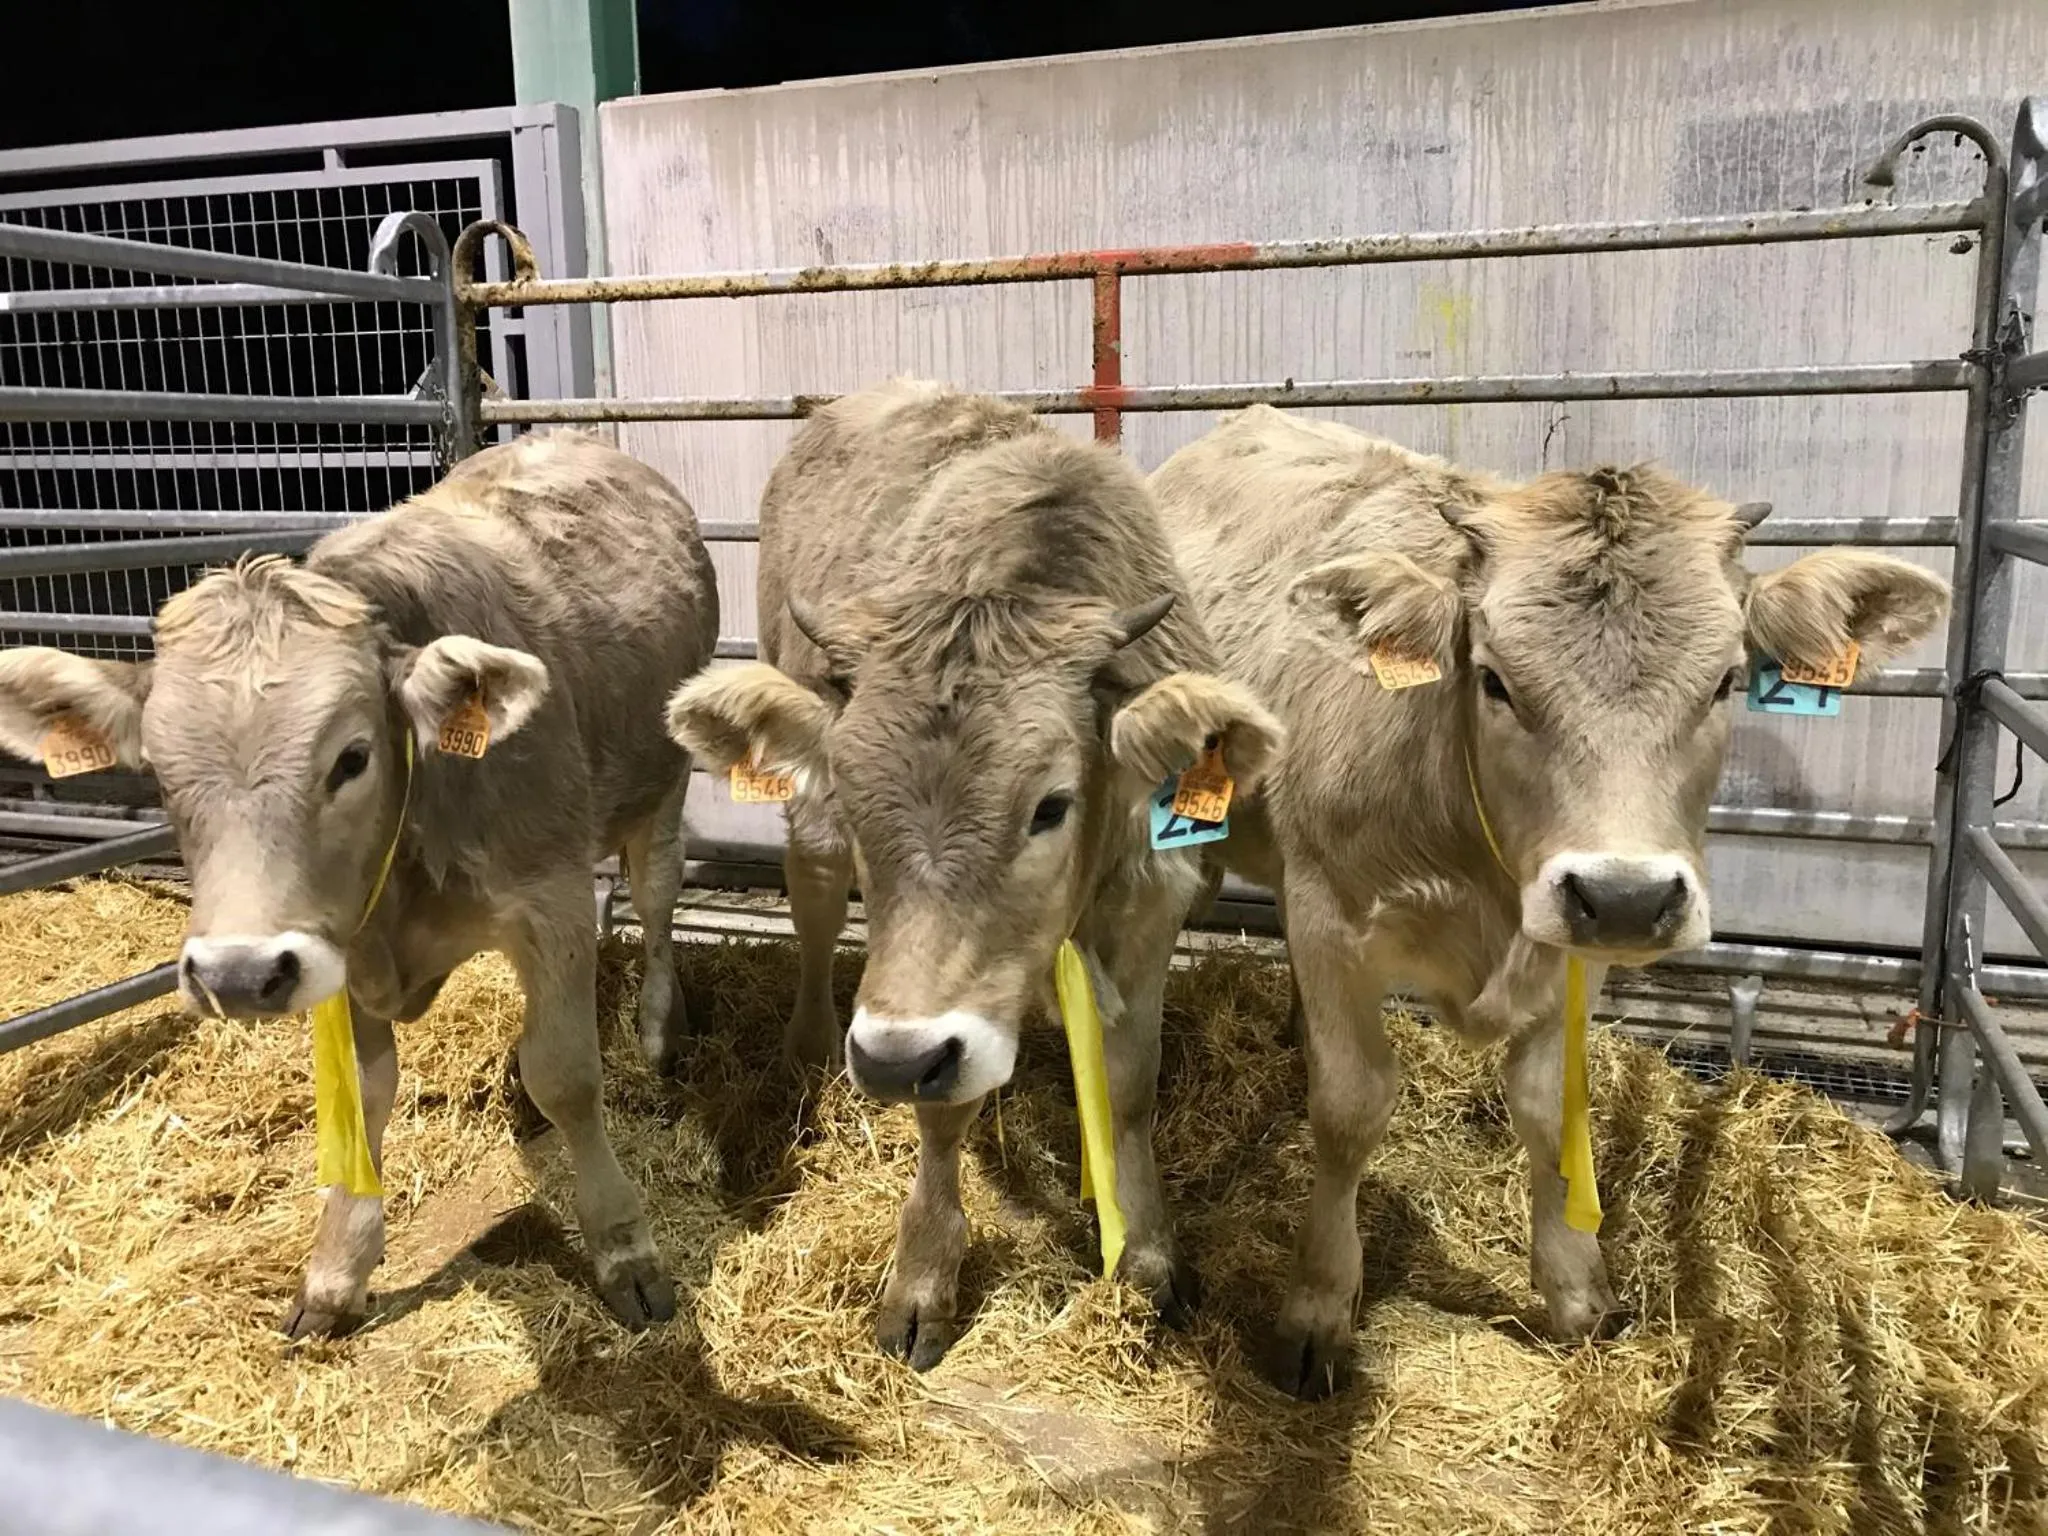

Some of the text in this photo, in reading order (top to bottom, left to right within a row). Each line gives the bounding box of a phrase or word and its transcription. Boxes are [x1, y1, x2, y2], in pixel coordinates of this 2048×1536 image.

[441, 727, 484, 756] 3990
[50, 743, 112, 774] 3990
[736, 778, 789, 799] 9546
[1176, 789, 1226, 819] 9546
